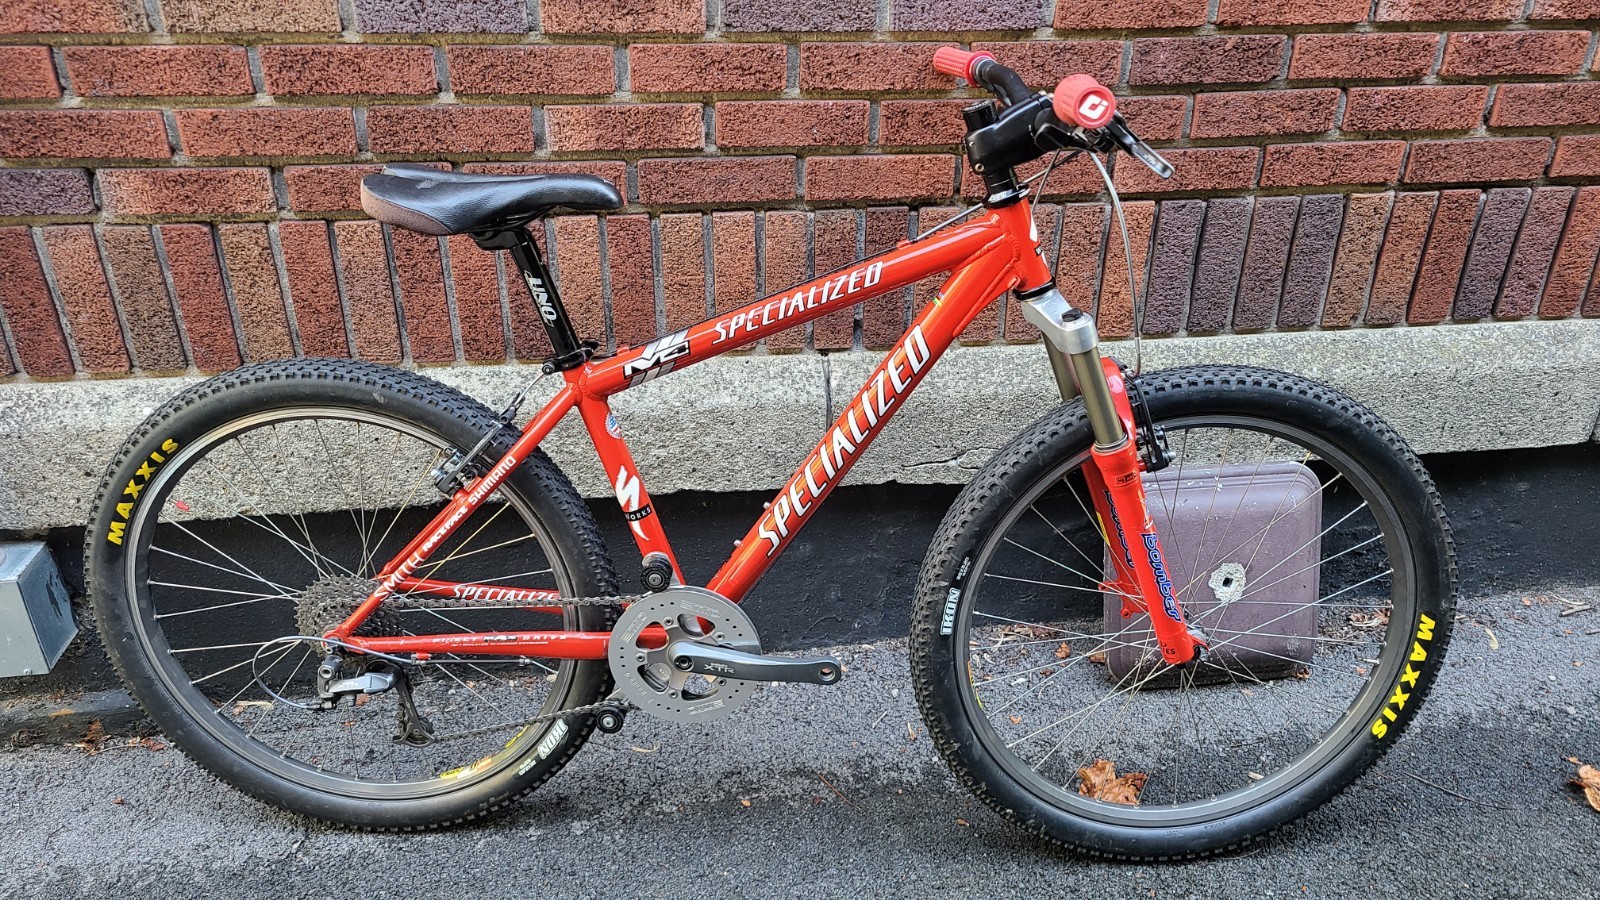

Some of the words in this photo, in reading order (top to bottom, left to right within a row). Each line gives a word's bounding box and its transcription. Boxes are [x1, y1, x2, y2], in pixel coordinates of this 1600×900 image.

[527, 277, 557, 321] UNO
[712, 261, 883, 345] SPECIALIZED
[758, 324, 931, 557] SPECIALIZED
[107, 438, 179, 546] MAXXIS
[468, 456, 517, 506] SHIMANO
[374, 551, 425, 602] SMITH
[449, 585, 561, 600] SPECIALIZE
[1140, 532, 1183, 623] bomber
[940, 587, 962, 636] IKON
[703, 664, 735, 674] XTR
[1371, 613, 1436, 740] MAXXIS
[537, 718, 569, 760] IKON
